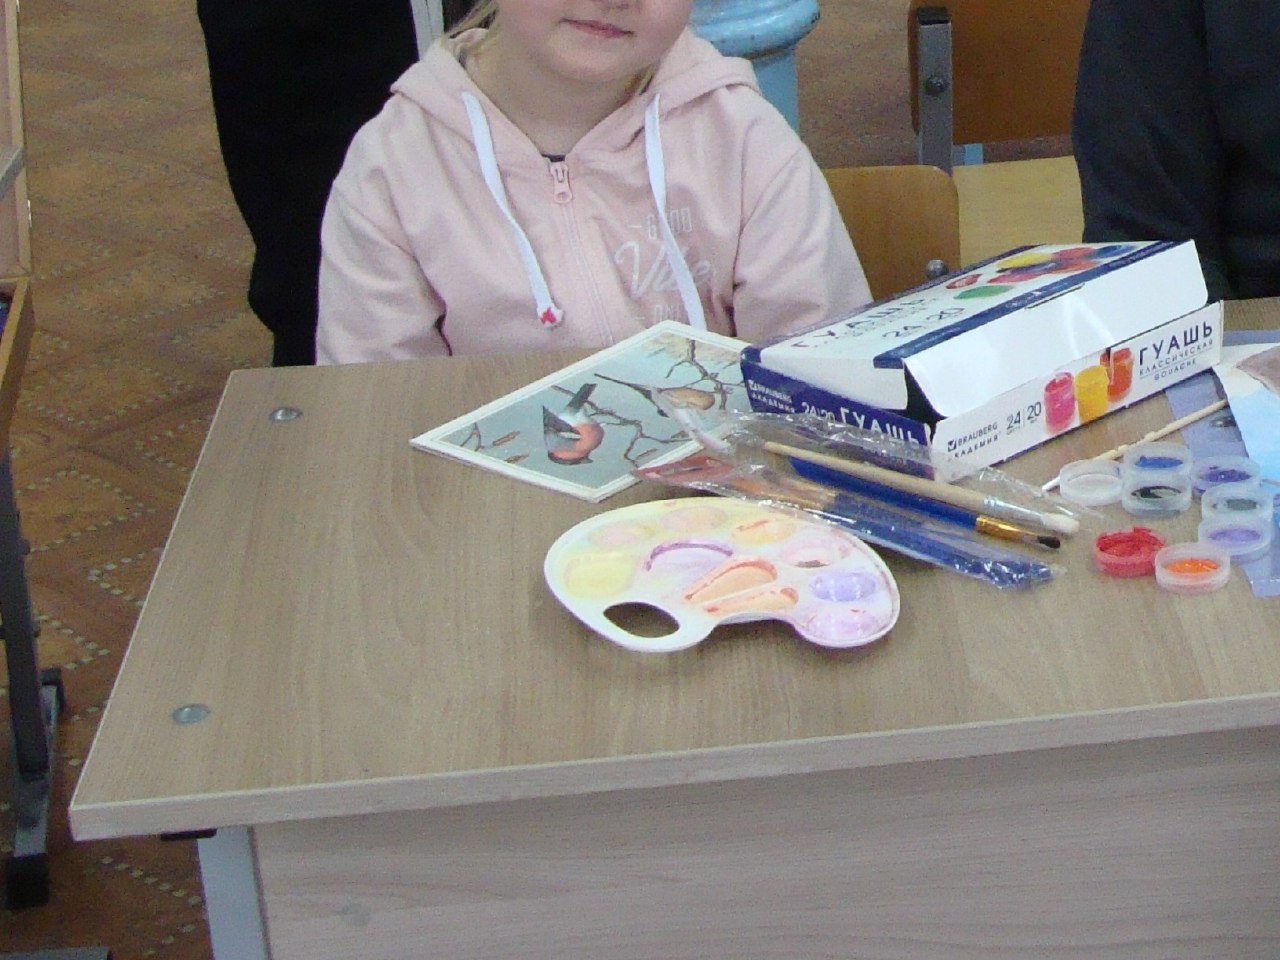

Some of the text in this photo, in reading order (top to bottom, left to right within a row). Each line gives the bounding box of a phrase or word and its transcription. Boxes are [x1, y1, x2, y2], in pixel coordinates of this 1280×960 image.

[1139, 321, 1213, 366] ГУАШЬ
[1139, 339, 1213, 376] КЛАССИЧЕСКАЯ
[1154, 358, 1197, 381] GOUACHE
[840, 406, 920, 448] ГУАШЬ
[1006, 401, 1042, 430] 24 20
[957, 421, 998, 447] BRAUBERG
